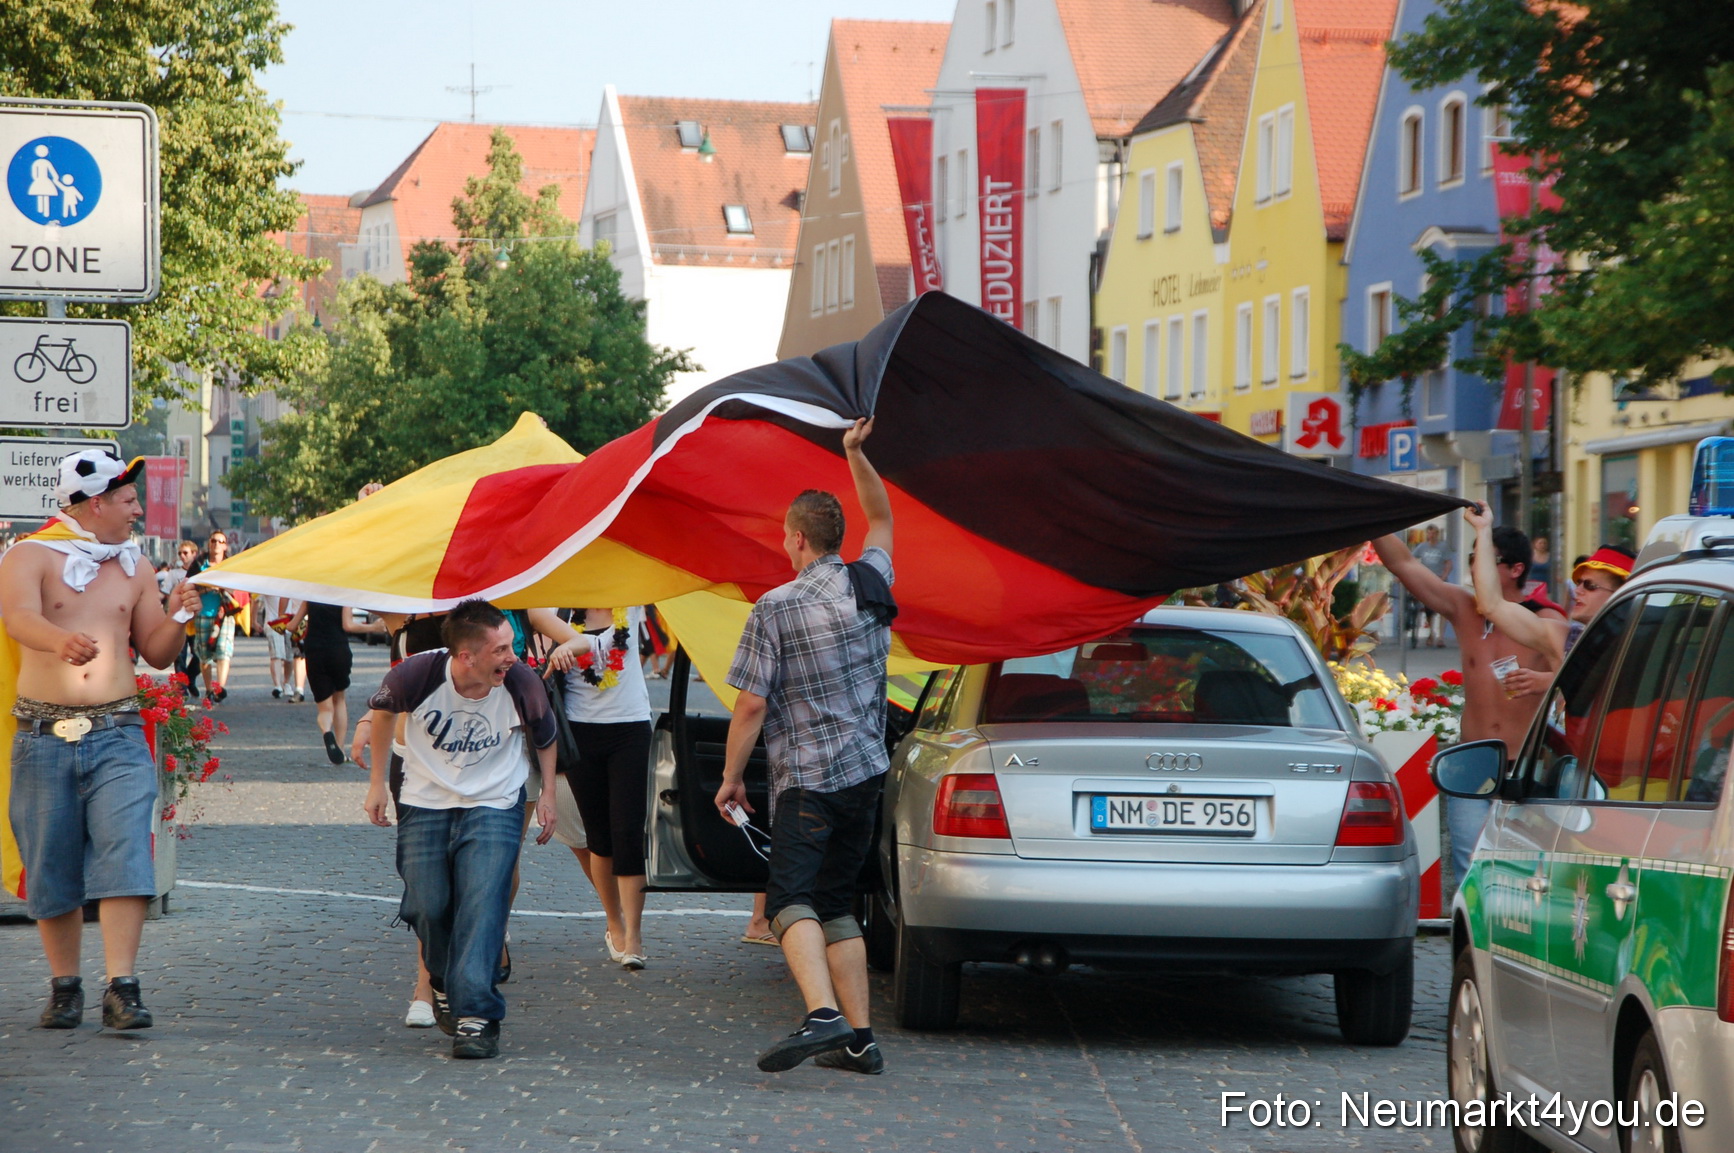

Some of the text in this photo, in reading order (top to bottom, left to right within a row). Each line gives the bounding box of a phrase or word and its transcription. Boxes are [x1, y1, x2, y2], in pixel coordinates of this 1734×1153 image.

[10, 245, 101, 273] ZONE
[983, 174, 1014, 326] EDUZIERT
[1152, 274, 1182, 307] HOTEL
[34, 391, 78, 413] frei
[1395, 433, 1412, 467] P
[423, 709, 501, 750] Yankees
[1110, 800, 1143, 824] NM
[1162, 801, 1196, 825] DE
[1203, 803, 1251, 827] 956
